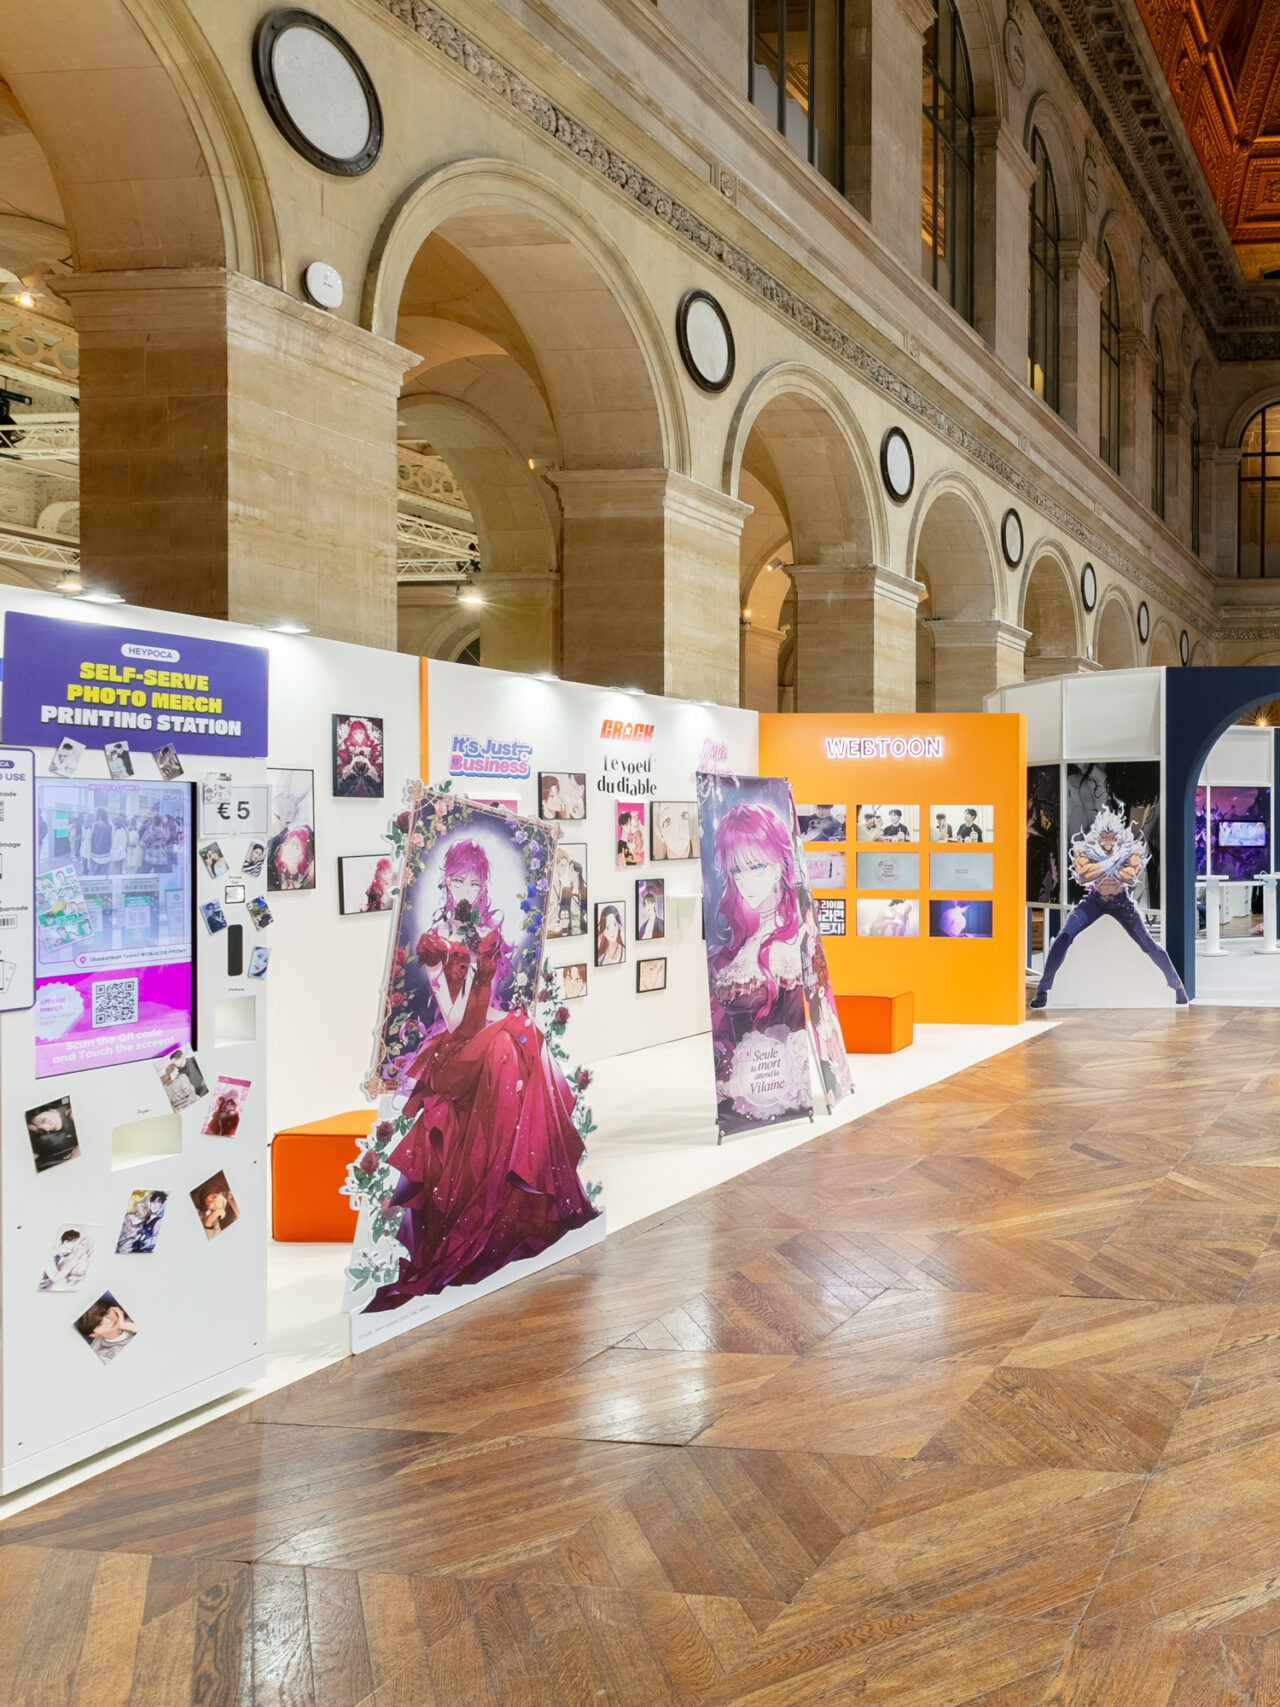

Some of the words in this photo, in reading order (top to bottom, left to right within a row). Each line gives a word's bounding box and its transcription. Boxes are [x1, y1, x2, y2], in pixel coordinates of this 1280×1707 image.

[128, 646, 174, 660] HEYPOCA
[79, 662, 210, 692] SELF-SERVE
[66, 684, 147, 707] PHOTO
[150, 692, 223, 714] MERCH
[40, 705, 153, 730] PRINTING
[156, 714, 242, 736] STATION
[600, 719, 655, 742] CRACK
[452, 736, 479, 753] It's
[481, 739, 519, 756] Just
[825, 736, 944, 759] WEBTOON
[450, 754, 528, 775] Business
[603, 754, 619, 772] Le
[5, 773, 26, 781] USE
[597, 776, 615, 794] du
[616, 777, 657, 796] diable
[217, 802, 231, 820] €
[237, 801, 250, 820] 5
[66, 1038, 97, 1050] Scan
[97, 1034, 116, 1044] the
[117, 1031, 135, 1043] QR
[136, 1028, 163, 1038] code
[52, 1052, 76, 1064] and
[78, 1046, 114, 1059] Touch
[115, 1044, 134, 1053] the
[136, 1036, 175, 1047] screen!
[753, 1048, 778, 1062] Seule
[757, 1058, 782, 1072] mort
[750, 1079, 786, 1095] Vilaine
